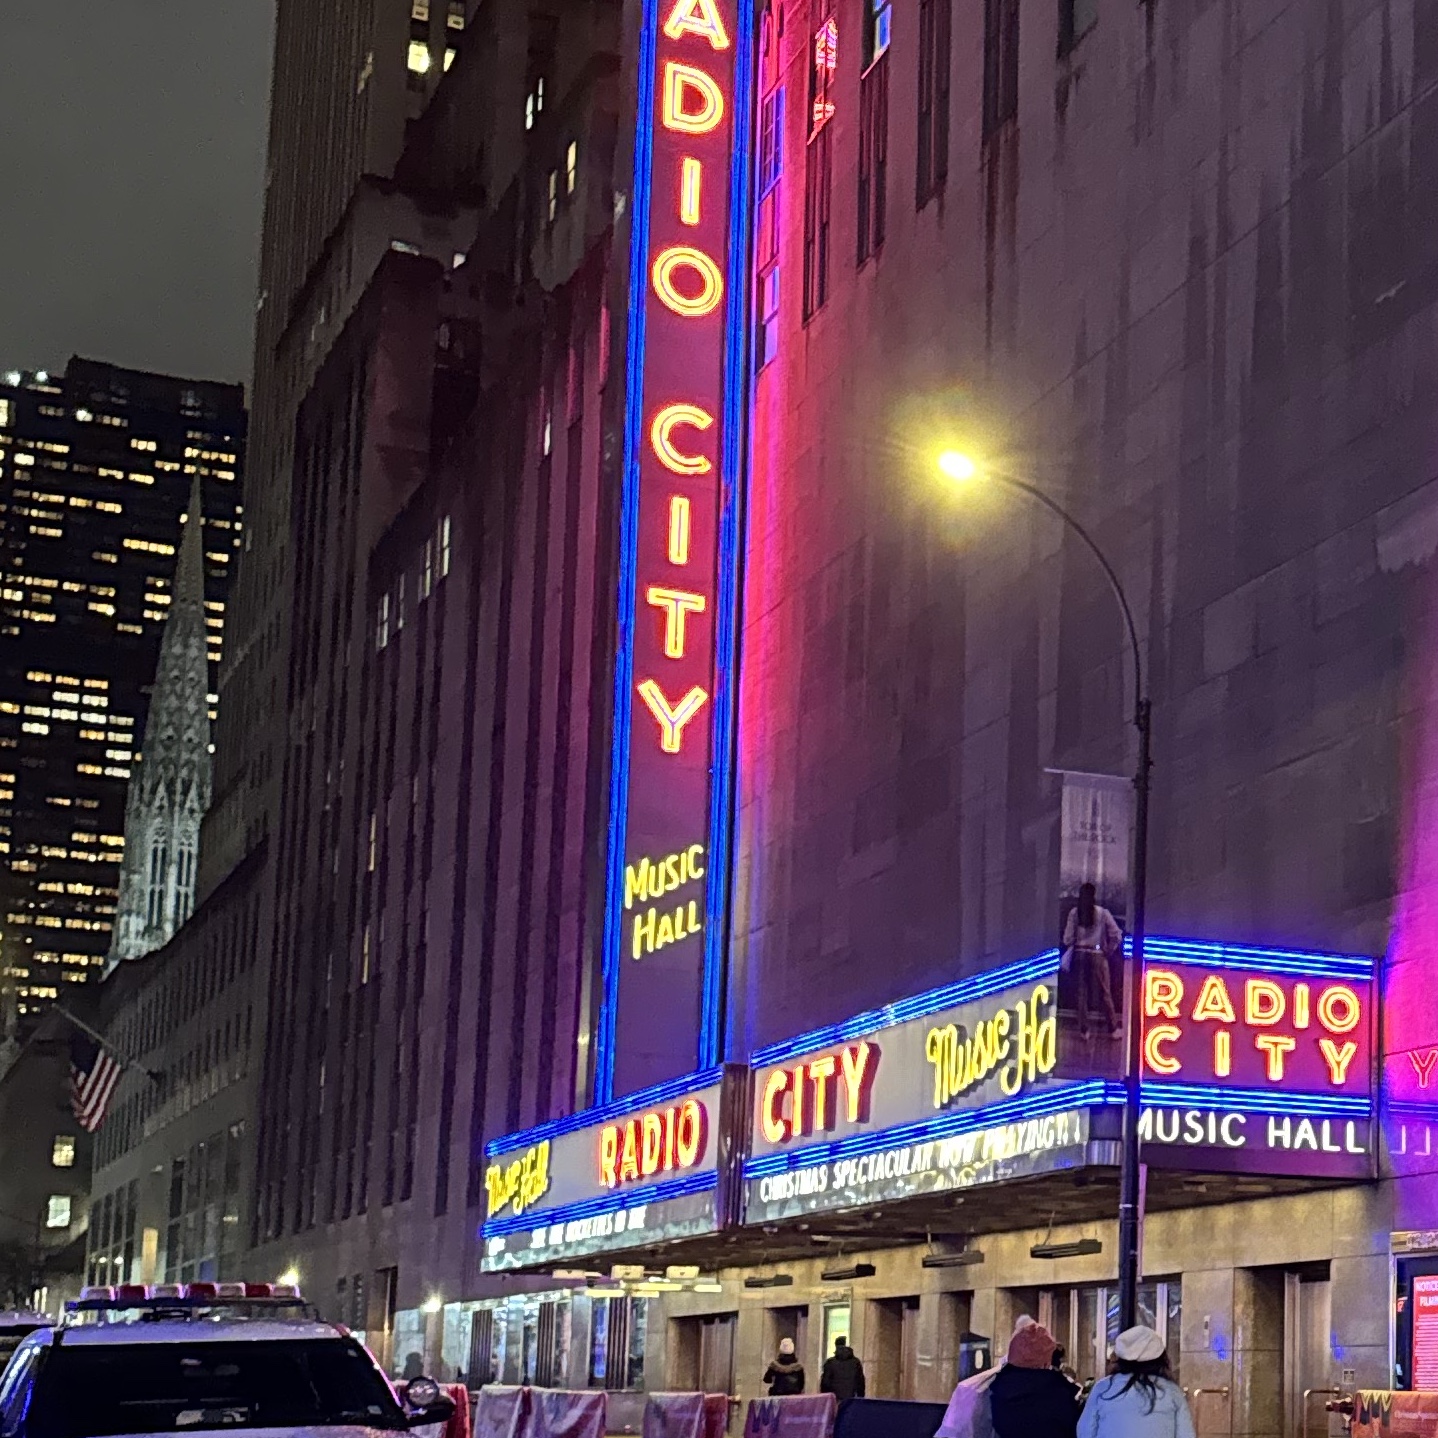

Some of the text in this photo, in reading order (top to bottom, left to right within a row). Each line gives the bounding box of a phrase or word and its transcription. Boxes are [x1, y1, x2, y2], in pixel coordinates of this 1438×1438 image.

[636, 403, 715, 755] CITY
[624, 843, 705, 910] MUSIC
[632, 900, 702, 960] HALL
[1145, 968, 1361, 1035] RADIO
[761, 984, 1057, 1143] CITY Music Ha
[1145, 1023, 1358, 1085] CITY
[599, 1098, 702, 1189] RADIO
[832, 1141, 934, 1190] SPECTACULAR
[1268, 1115, 1365, 1154] HALL
